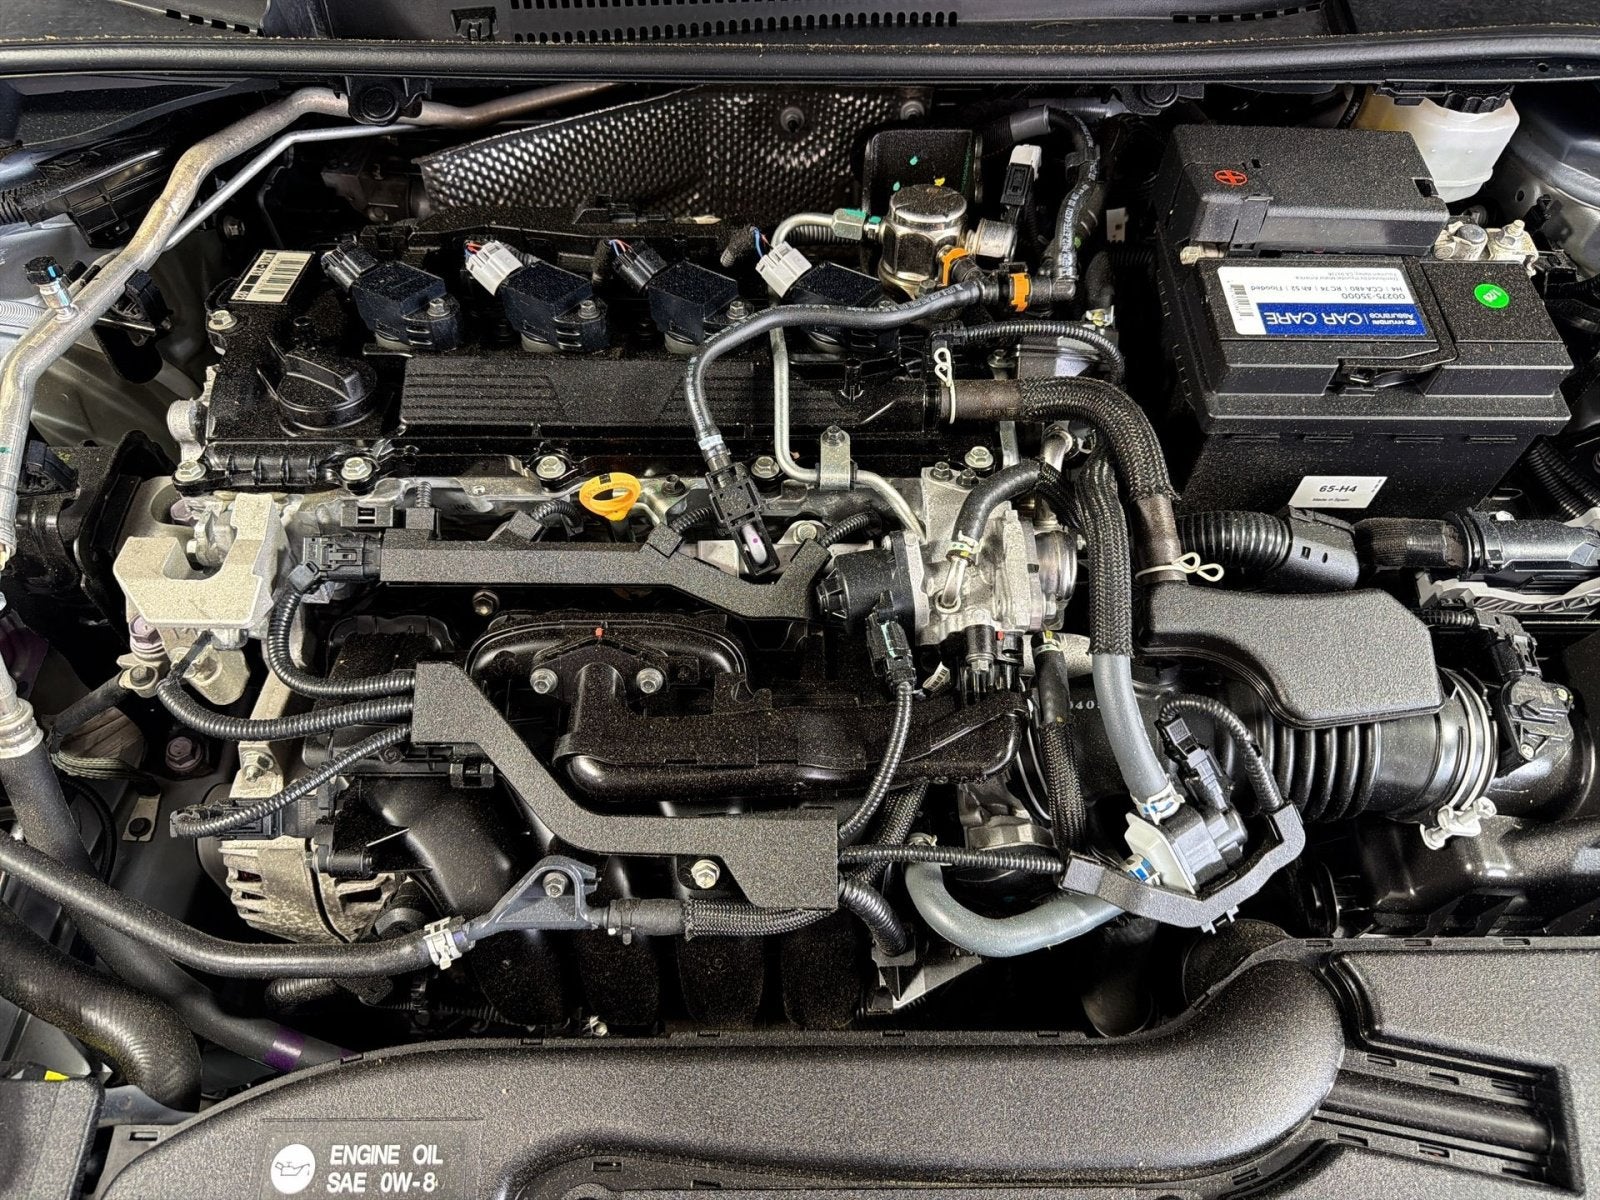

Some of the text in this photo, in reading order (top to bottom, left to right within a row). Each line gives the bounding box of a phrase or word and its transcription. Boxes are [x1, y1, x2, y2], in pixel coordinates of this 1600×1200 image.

[1265, 312, 1362, 324] CAR CARE
[330, 1144, 444, 1165] ENGINE OIL
[326, 1172, 436, 1193] SAE 0W-8
